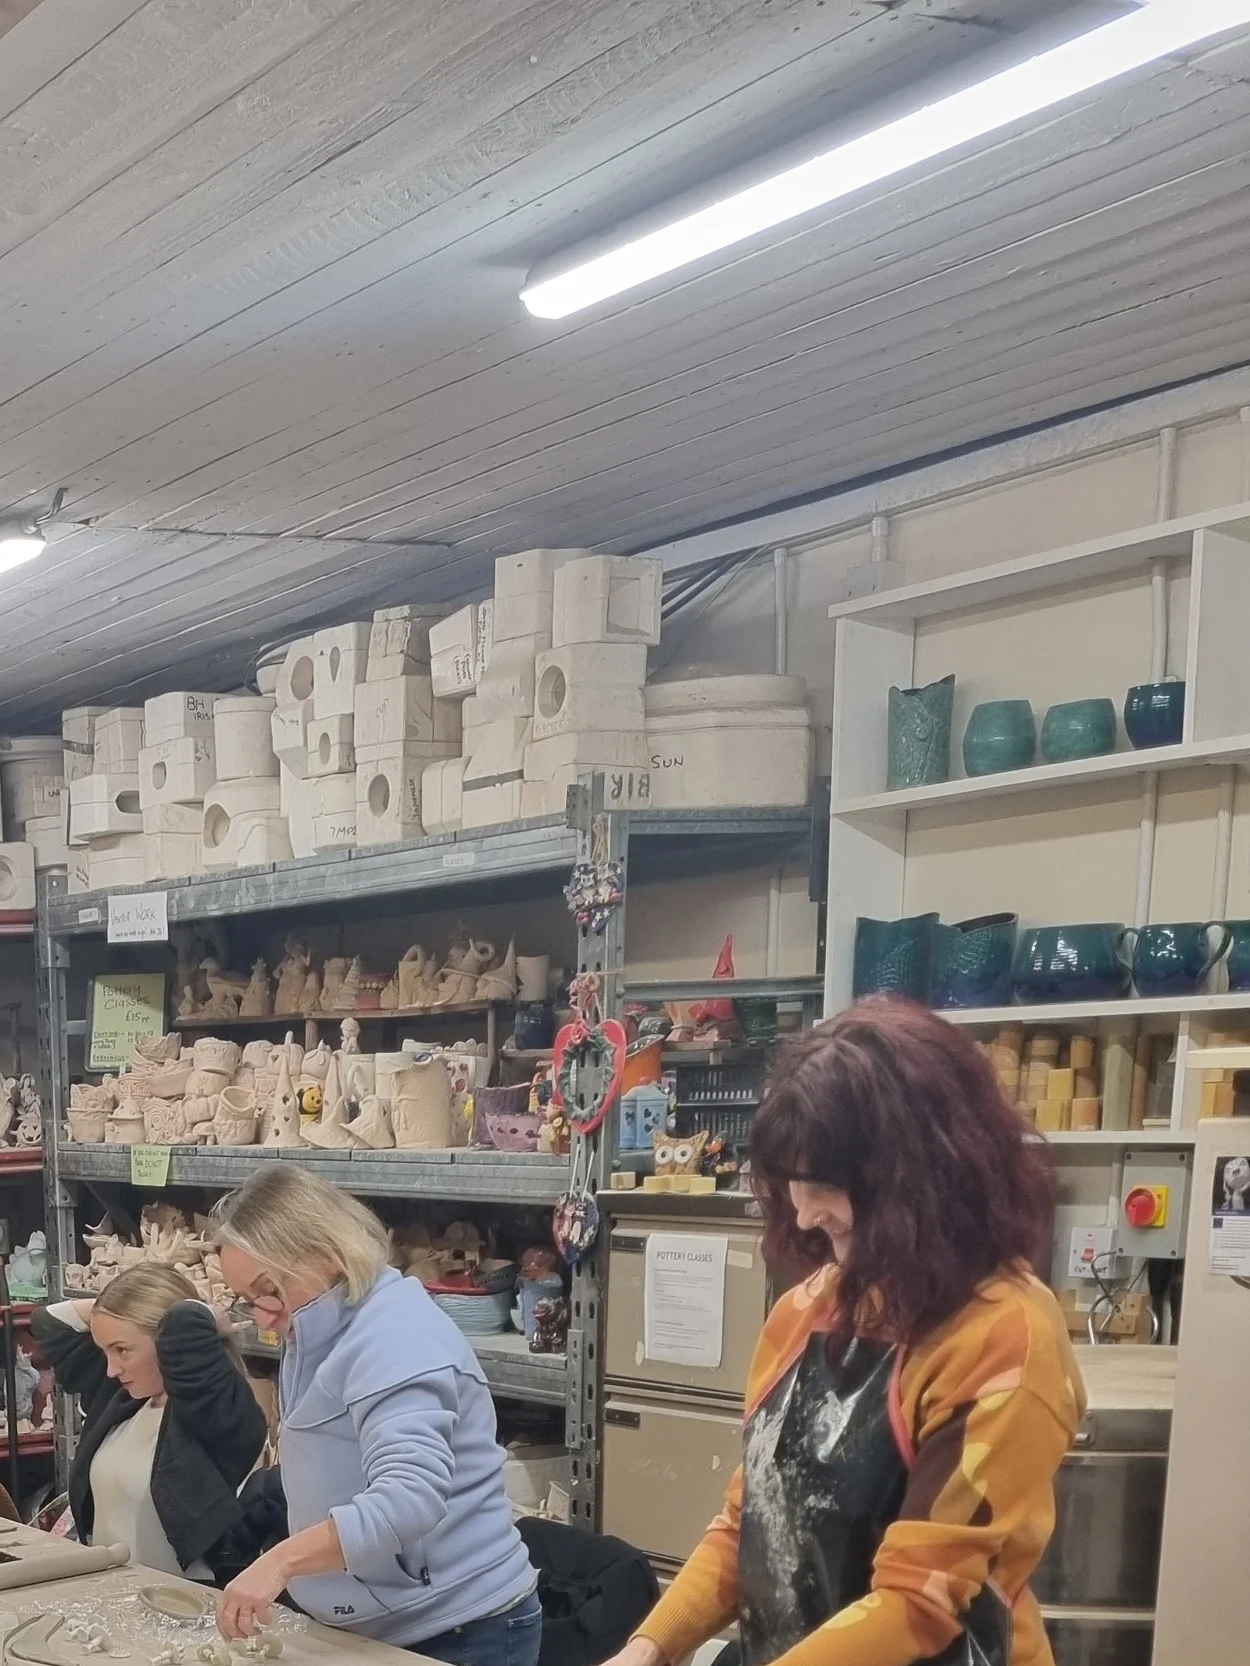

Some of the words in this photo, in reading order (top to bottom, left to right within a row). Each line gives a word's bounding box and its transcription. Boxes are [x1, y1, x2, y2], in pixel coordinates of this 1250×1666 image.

[651, 754, 684, 769] SUN
[656, 1250, 686, 1261] POTTERY
[686, 1252, 713, 1263] CLASSES
[333, 1604, 356, 1616] FILA
